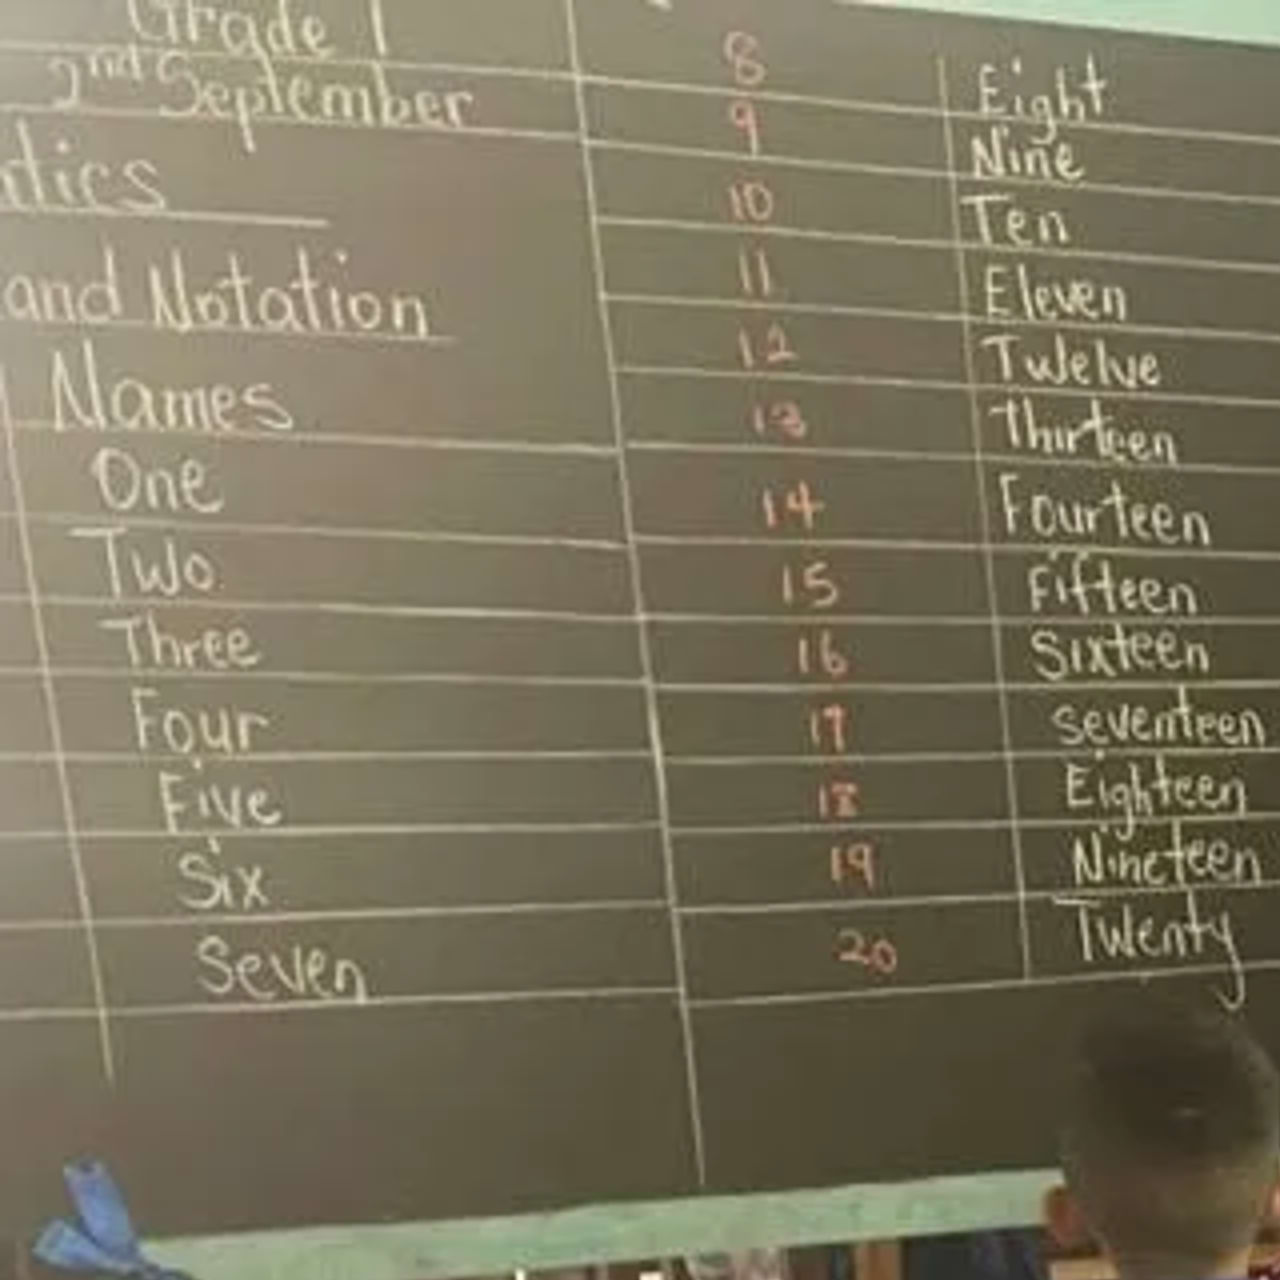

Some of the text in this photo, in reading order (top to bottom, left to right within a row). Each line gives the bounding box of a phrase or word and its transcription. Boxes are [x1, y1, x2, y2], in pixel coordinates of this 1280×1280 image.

[723, 31, 766, 86] 8
[157, 48, 475, 153] September
[977, 52, 1107, 145] Eight
[727, 101, 762, 158] 9
[968, 128, 1086, 182] Nine
[727, 182, 774, 222] 10
[961, 195, 1070, 247] Ten
[6, 243, 430, 336] and Notation
[737, 247, 772, 296] 11
[983, 264, 1128, 323] Eleven
[736, 324, 797, 370] 12
[979, 334, 1163, 388] Twelve
[50, 338, 294, 432] Names
[753, 402, 807, 438] 13
[987, 402, 1179, 467] Thirteen
[90, 447, 225, 513] One
[760, 480, 824, 530] 14
[998, 473, 1210, 546] Fourteen
[71, 526, 217, 598] Two
[780, 563, 840, 608] 15
[1025, 546, 1200, 616] Fifteen
[98, 616, 260, 668] Three
[798, 633, 849, 676] 16
[1028, 626, 1211, 682] Sixteen
[131, 687, 270, 754] Four
[808, 702, 847, 752] 17
[158, 760, 282, 835] Five
[817, 780, 860, 820] 18
[1064, 748, 1248, 840] Eighteen
[179, 838, 270, 910] Six
[829, 842, 876, 890] 19
[1071, 818, 1262, 890] Nineteen
[197, 935, 368, 1005] Seven
[837, 928, 898, 972] 20
[1052, 890, 1248, 1011] Twenty
